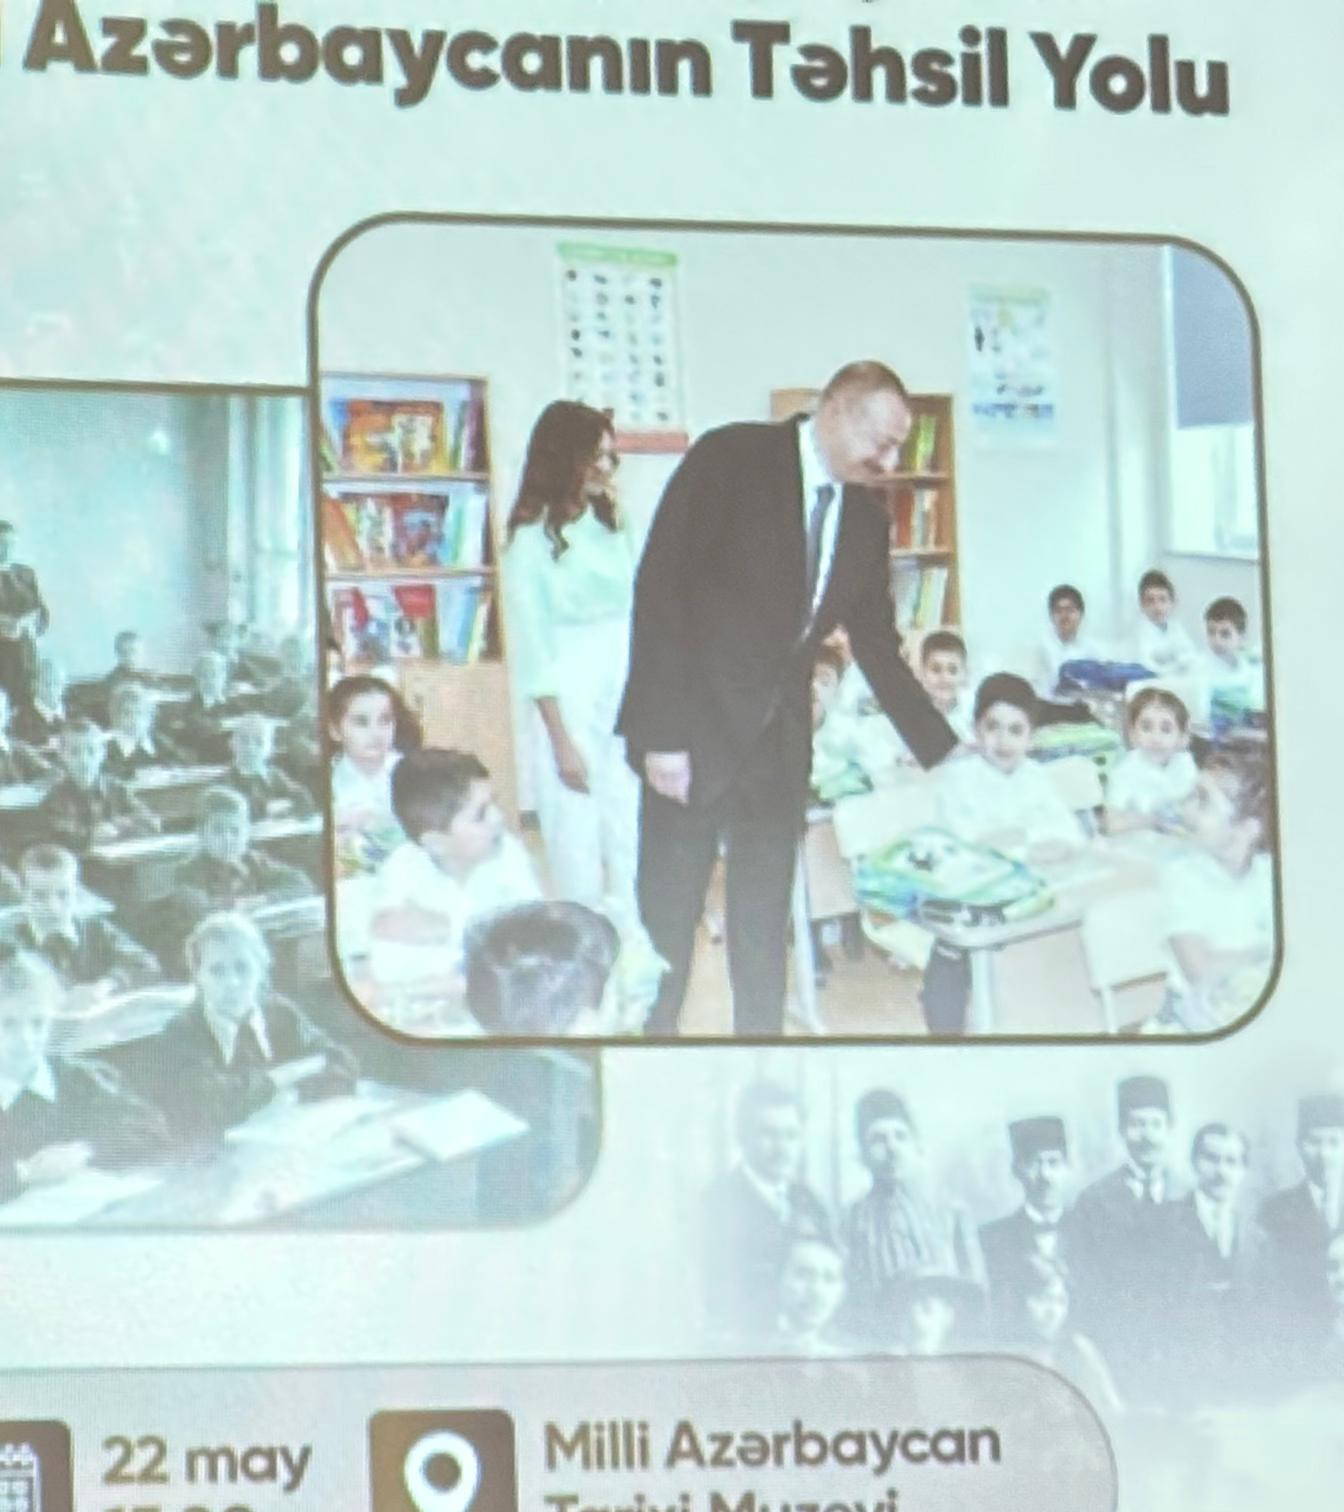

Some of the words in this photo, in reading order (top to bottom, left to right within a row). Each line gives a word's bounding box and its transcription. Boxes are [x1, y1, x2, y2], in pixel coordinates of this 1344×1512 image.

[23, 0, 712, 108] Azərbaycanın
[732, 20, 1009, 107] Təhsil
[1029, 32, 1229, 116] Yolu
[103, 1434, 170, 1484] 22
[185, 1445, 313, 1495] may
[545, 1420, 650, 1471] Milli
[665, 1418, 1002, 1477] Azərbaycan
